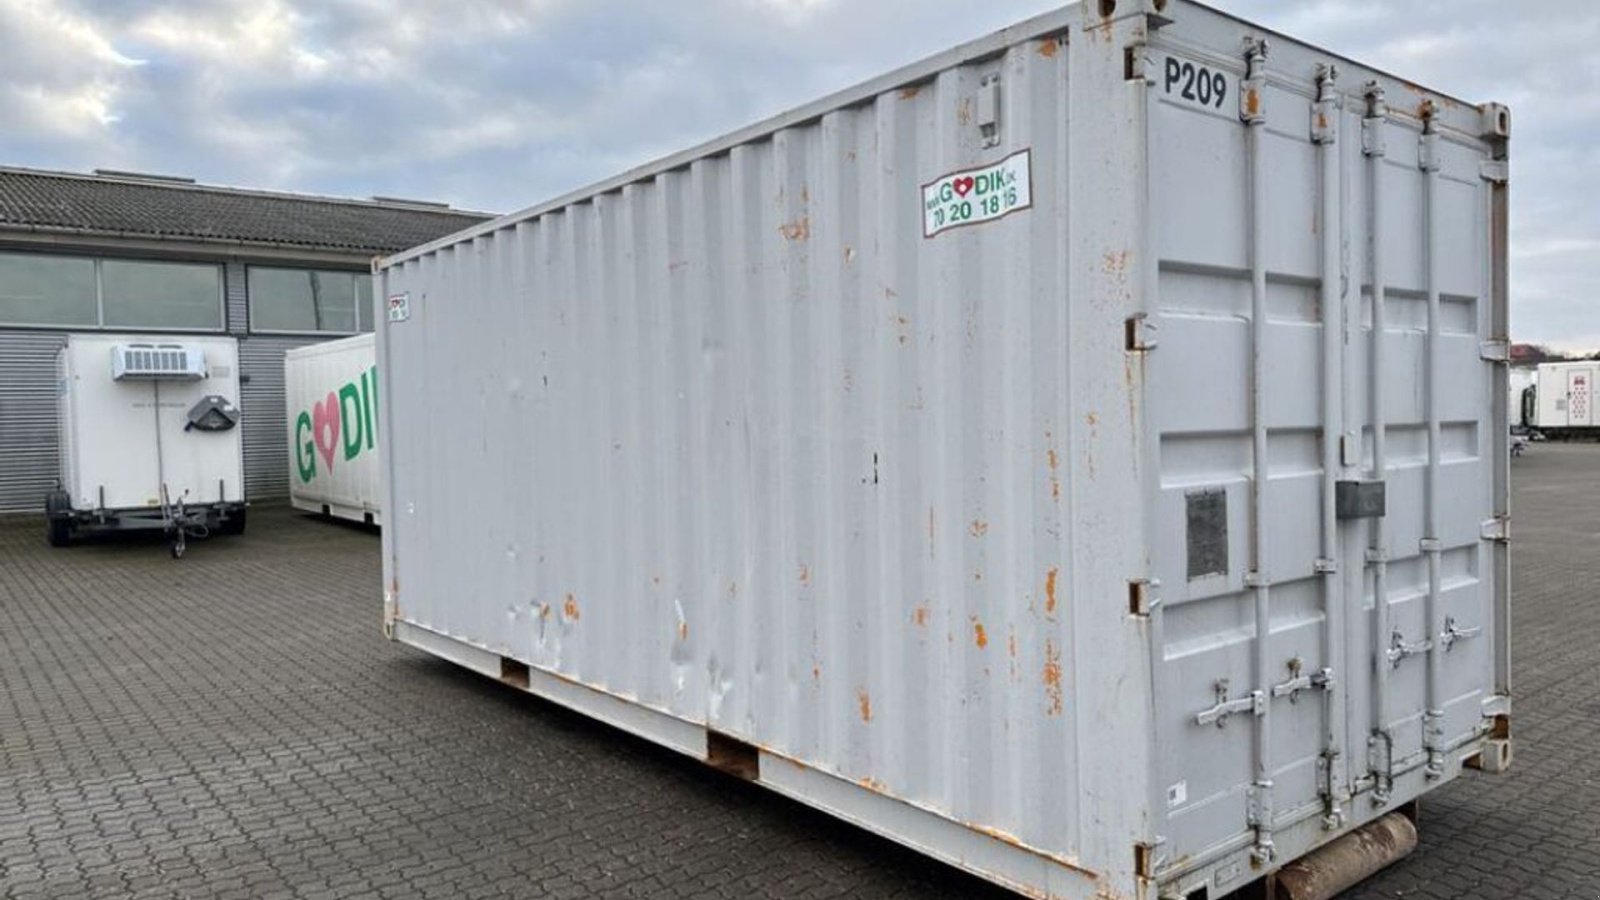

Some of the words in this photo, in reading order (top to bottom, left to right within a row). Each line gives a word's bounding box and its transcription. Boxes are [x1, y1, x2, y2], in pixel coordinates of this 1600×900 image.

[1165, 56, 1226, 108] P209
[949, 201, 972, 221] 20
[980, 195, 1000, 216] 18
